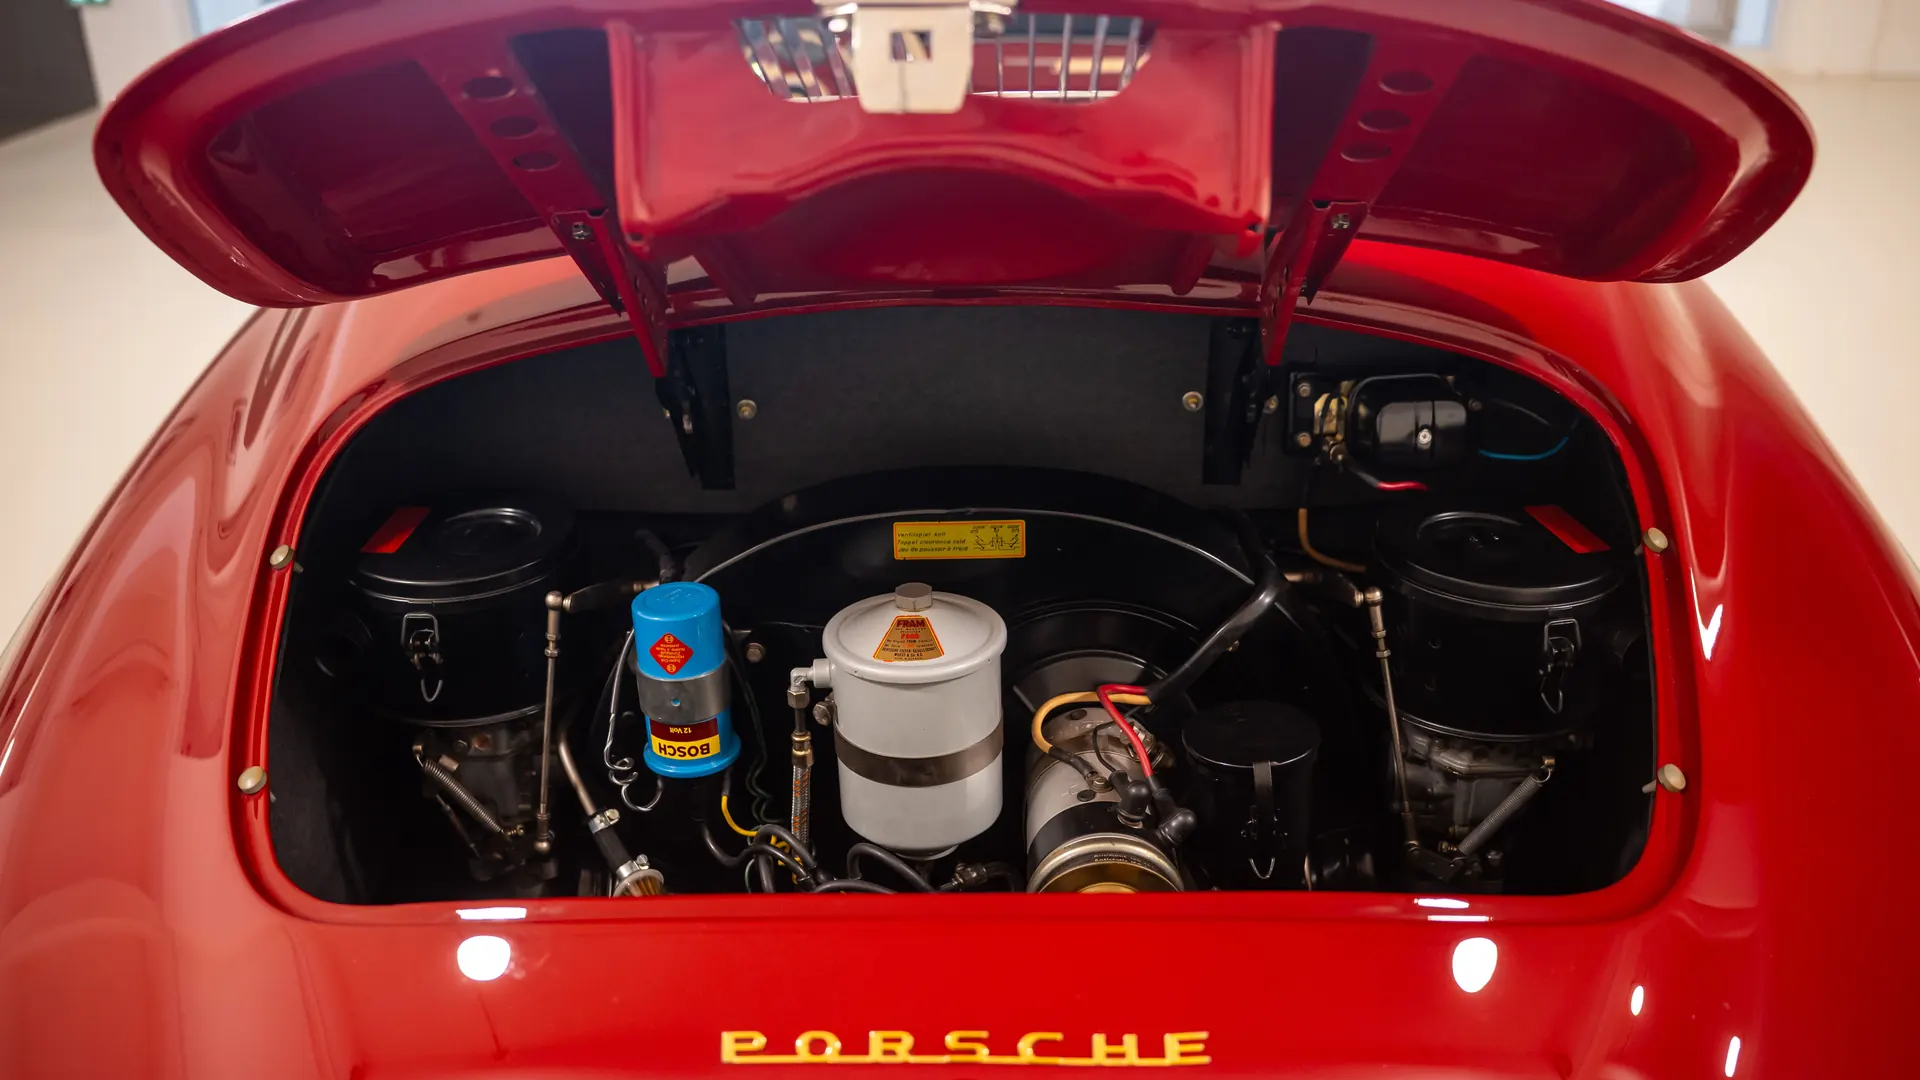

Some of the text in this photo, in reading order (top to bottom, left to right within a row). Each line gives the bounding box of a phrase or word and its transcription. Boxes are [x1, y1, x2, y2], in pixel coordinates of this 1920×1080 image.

[896, 619, 925, 628] FRAM
[658, 742, 710, 757] BOSCH
[721, 1030, 1213, 1065] PORSCHE
